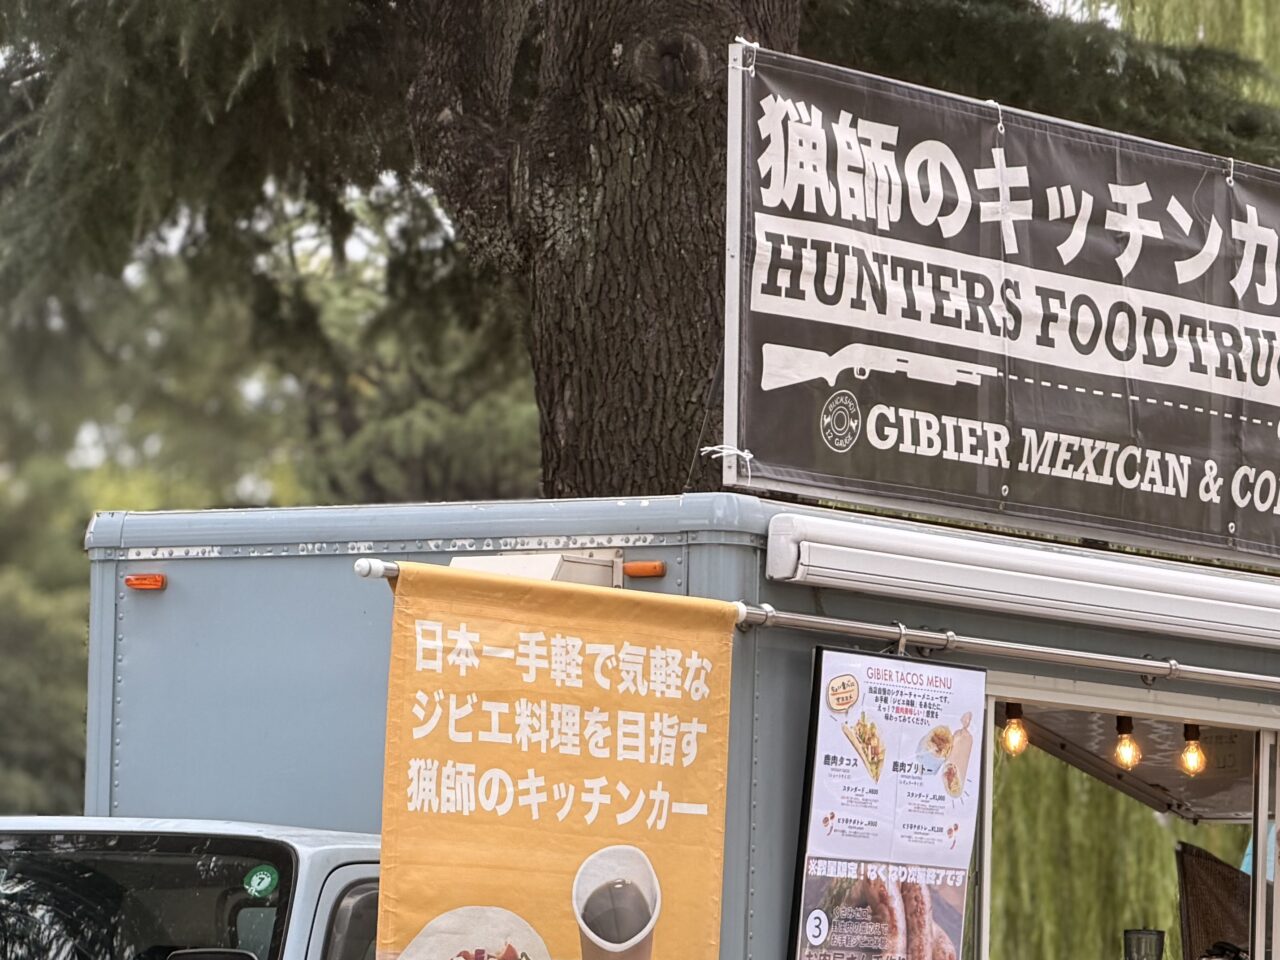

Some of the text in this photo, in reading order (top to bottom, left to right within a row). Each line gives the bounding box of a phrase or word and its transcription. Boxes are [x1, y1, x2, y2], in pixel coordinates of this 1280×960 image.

[760, 231, 1023, 341] HUNTERS
[866, 405, 1011, 471] GIBIER
[1018, 427, 1190, 498] MEXICAN
[1198, 460, 1225, 504] &
[414, 619, 713, 701] 日本一手軽で気軽な
[866, 667, 953, 690] GIBIER TACOS MENU
[412, 688, 707, 768] ジビエ料理を目指す
[823, 754, 858, 767] 鹿肉タコス
[406, 758, 709, 830] 猟師のキッチンカー
[892, 761, 933, 775] 鹿肉ブリトー
